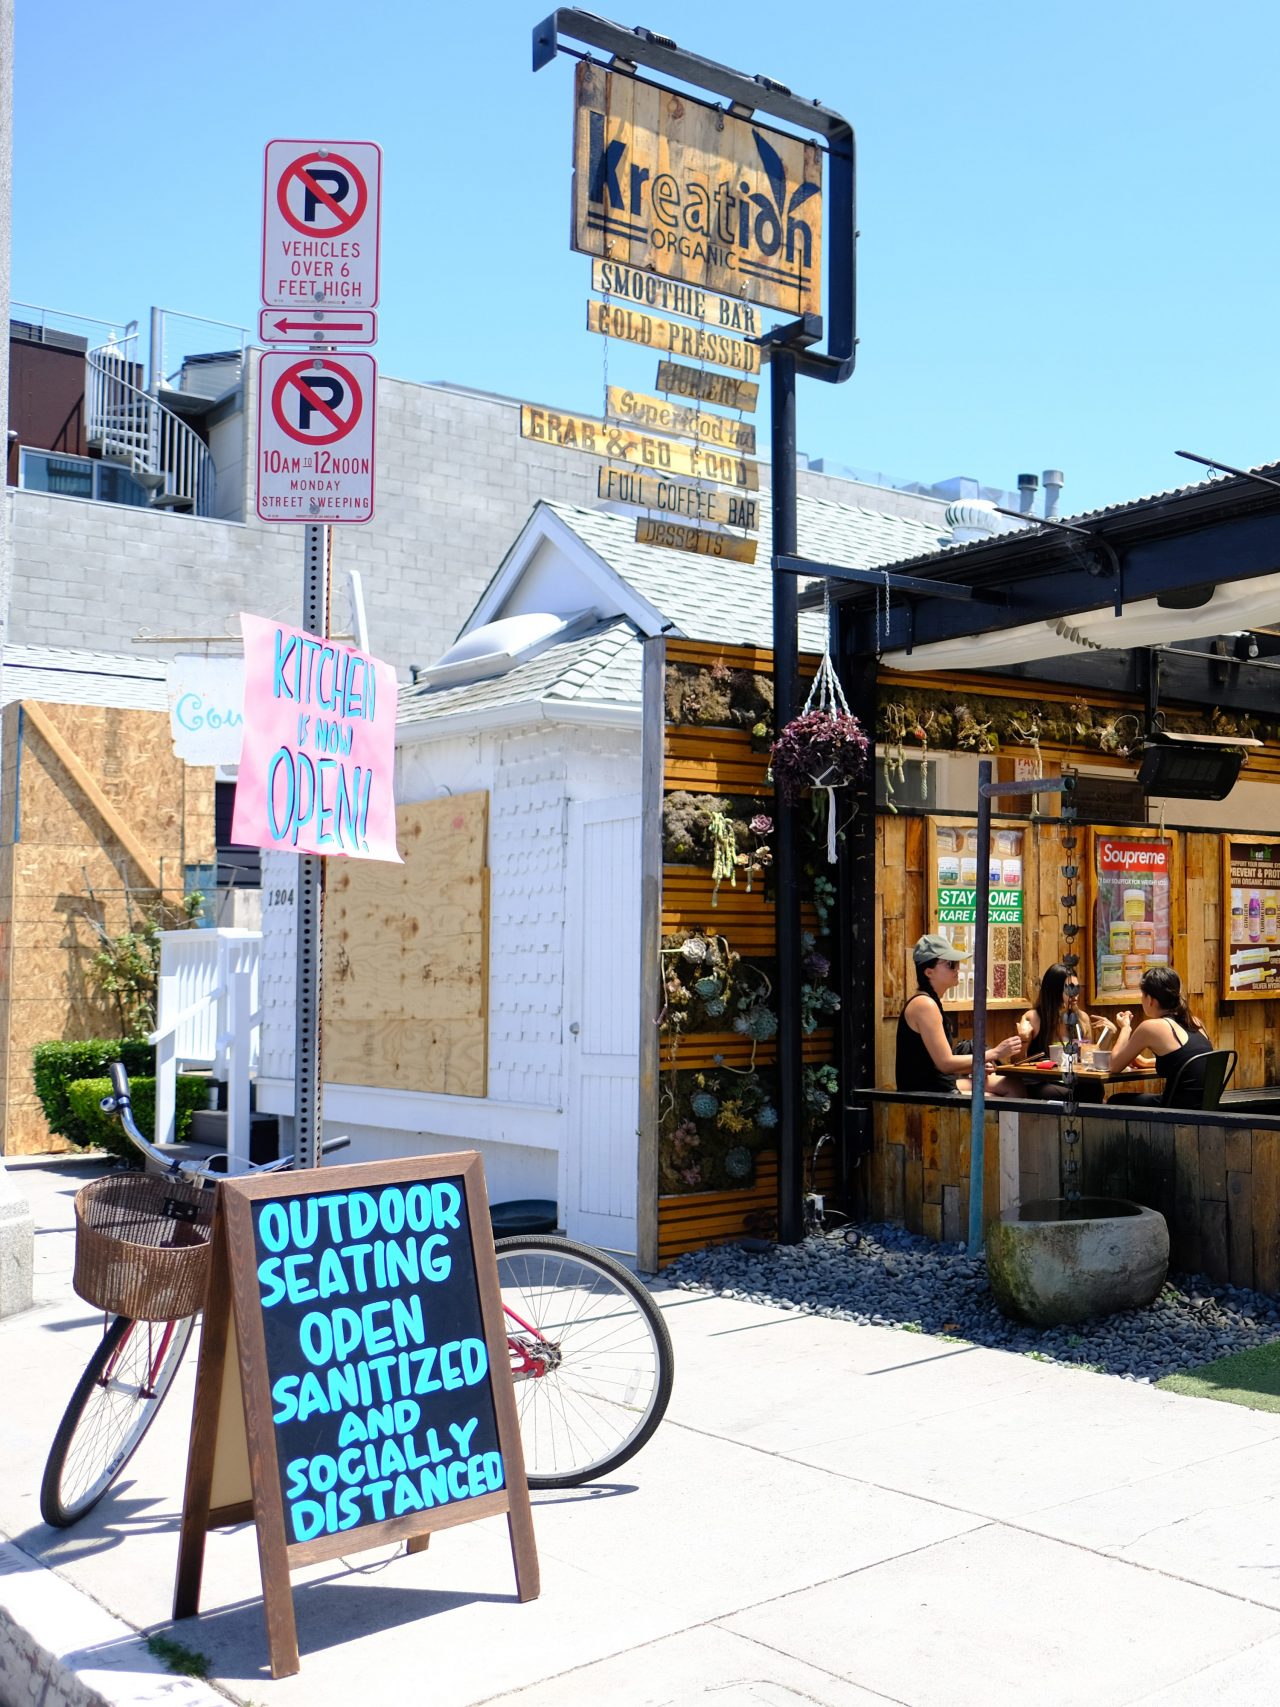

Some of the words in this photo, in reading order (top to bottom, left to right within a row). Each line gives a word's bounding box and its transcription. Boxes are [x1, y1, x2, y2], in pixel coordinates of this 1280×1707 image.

[589, 111, 813, 269] kreation
[282, 240, 361, 258] VEHICLES
[291, 261, 335, 276] OVER
[340, 261, 350, 277] 6
[650, 228, 737, 271] ORGANIC
[278, 279, 317, 295] FEET
[323, 281, 362, 297] HIGH
[601, 263, 706, 319] SMOOTHIE
[719, 297, 756, 334] BAR
[668, 319, 755, 371] PRESSED
[263, 449, 301, 474] 10AM
[303, 457, 312, 468] TO
[314, 450, 370, 475] 12NOON
[529, 410, 596, 452] GRAB
[605, 428, 638, 459] &
[641, 439, 671, 468] GO
[690, 448, 748, 485] FOOD
[262, 496, 305, 508] STREET
[309, 496, 370, 509] SWEEPING
[290, 479, 341, 491] MONDAY
[607, 470, 645, 505] FULL
[657, 482, 717, 520] COFFEE
[728, 498, 756, 528] BAR
[274, 629, 376, 722] KITCHEN
[298, 712, 311, 747] IS
[315, 718, 353, 757] NOW
[267, 746, 372, 852] OPEN!
[1103, 843, 1166, 869] Soupreme
[1258, 868, 1262, 878] &
[268, 889, 294, 906] 1204
[939, 909, 970, 921] KARE
[972, 910, 1020, 921] PCKAGE
[940, 890, 976, 905] STAY
[988, 891, 1019, 906] OME
[258, 1182, 461, 1253] OUTDOOR
[257, 1233, 452, 1308] SEATING
[299, 1294, 426, 1366] OPEN
[272, 1337, 488, 1424] SANITIZED
[337, 1399, 421, 1448] AND
[286, 1417, 479, 1499] SOCIALLY
[290, 1451, 505, 1542] DISTANCED
